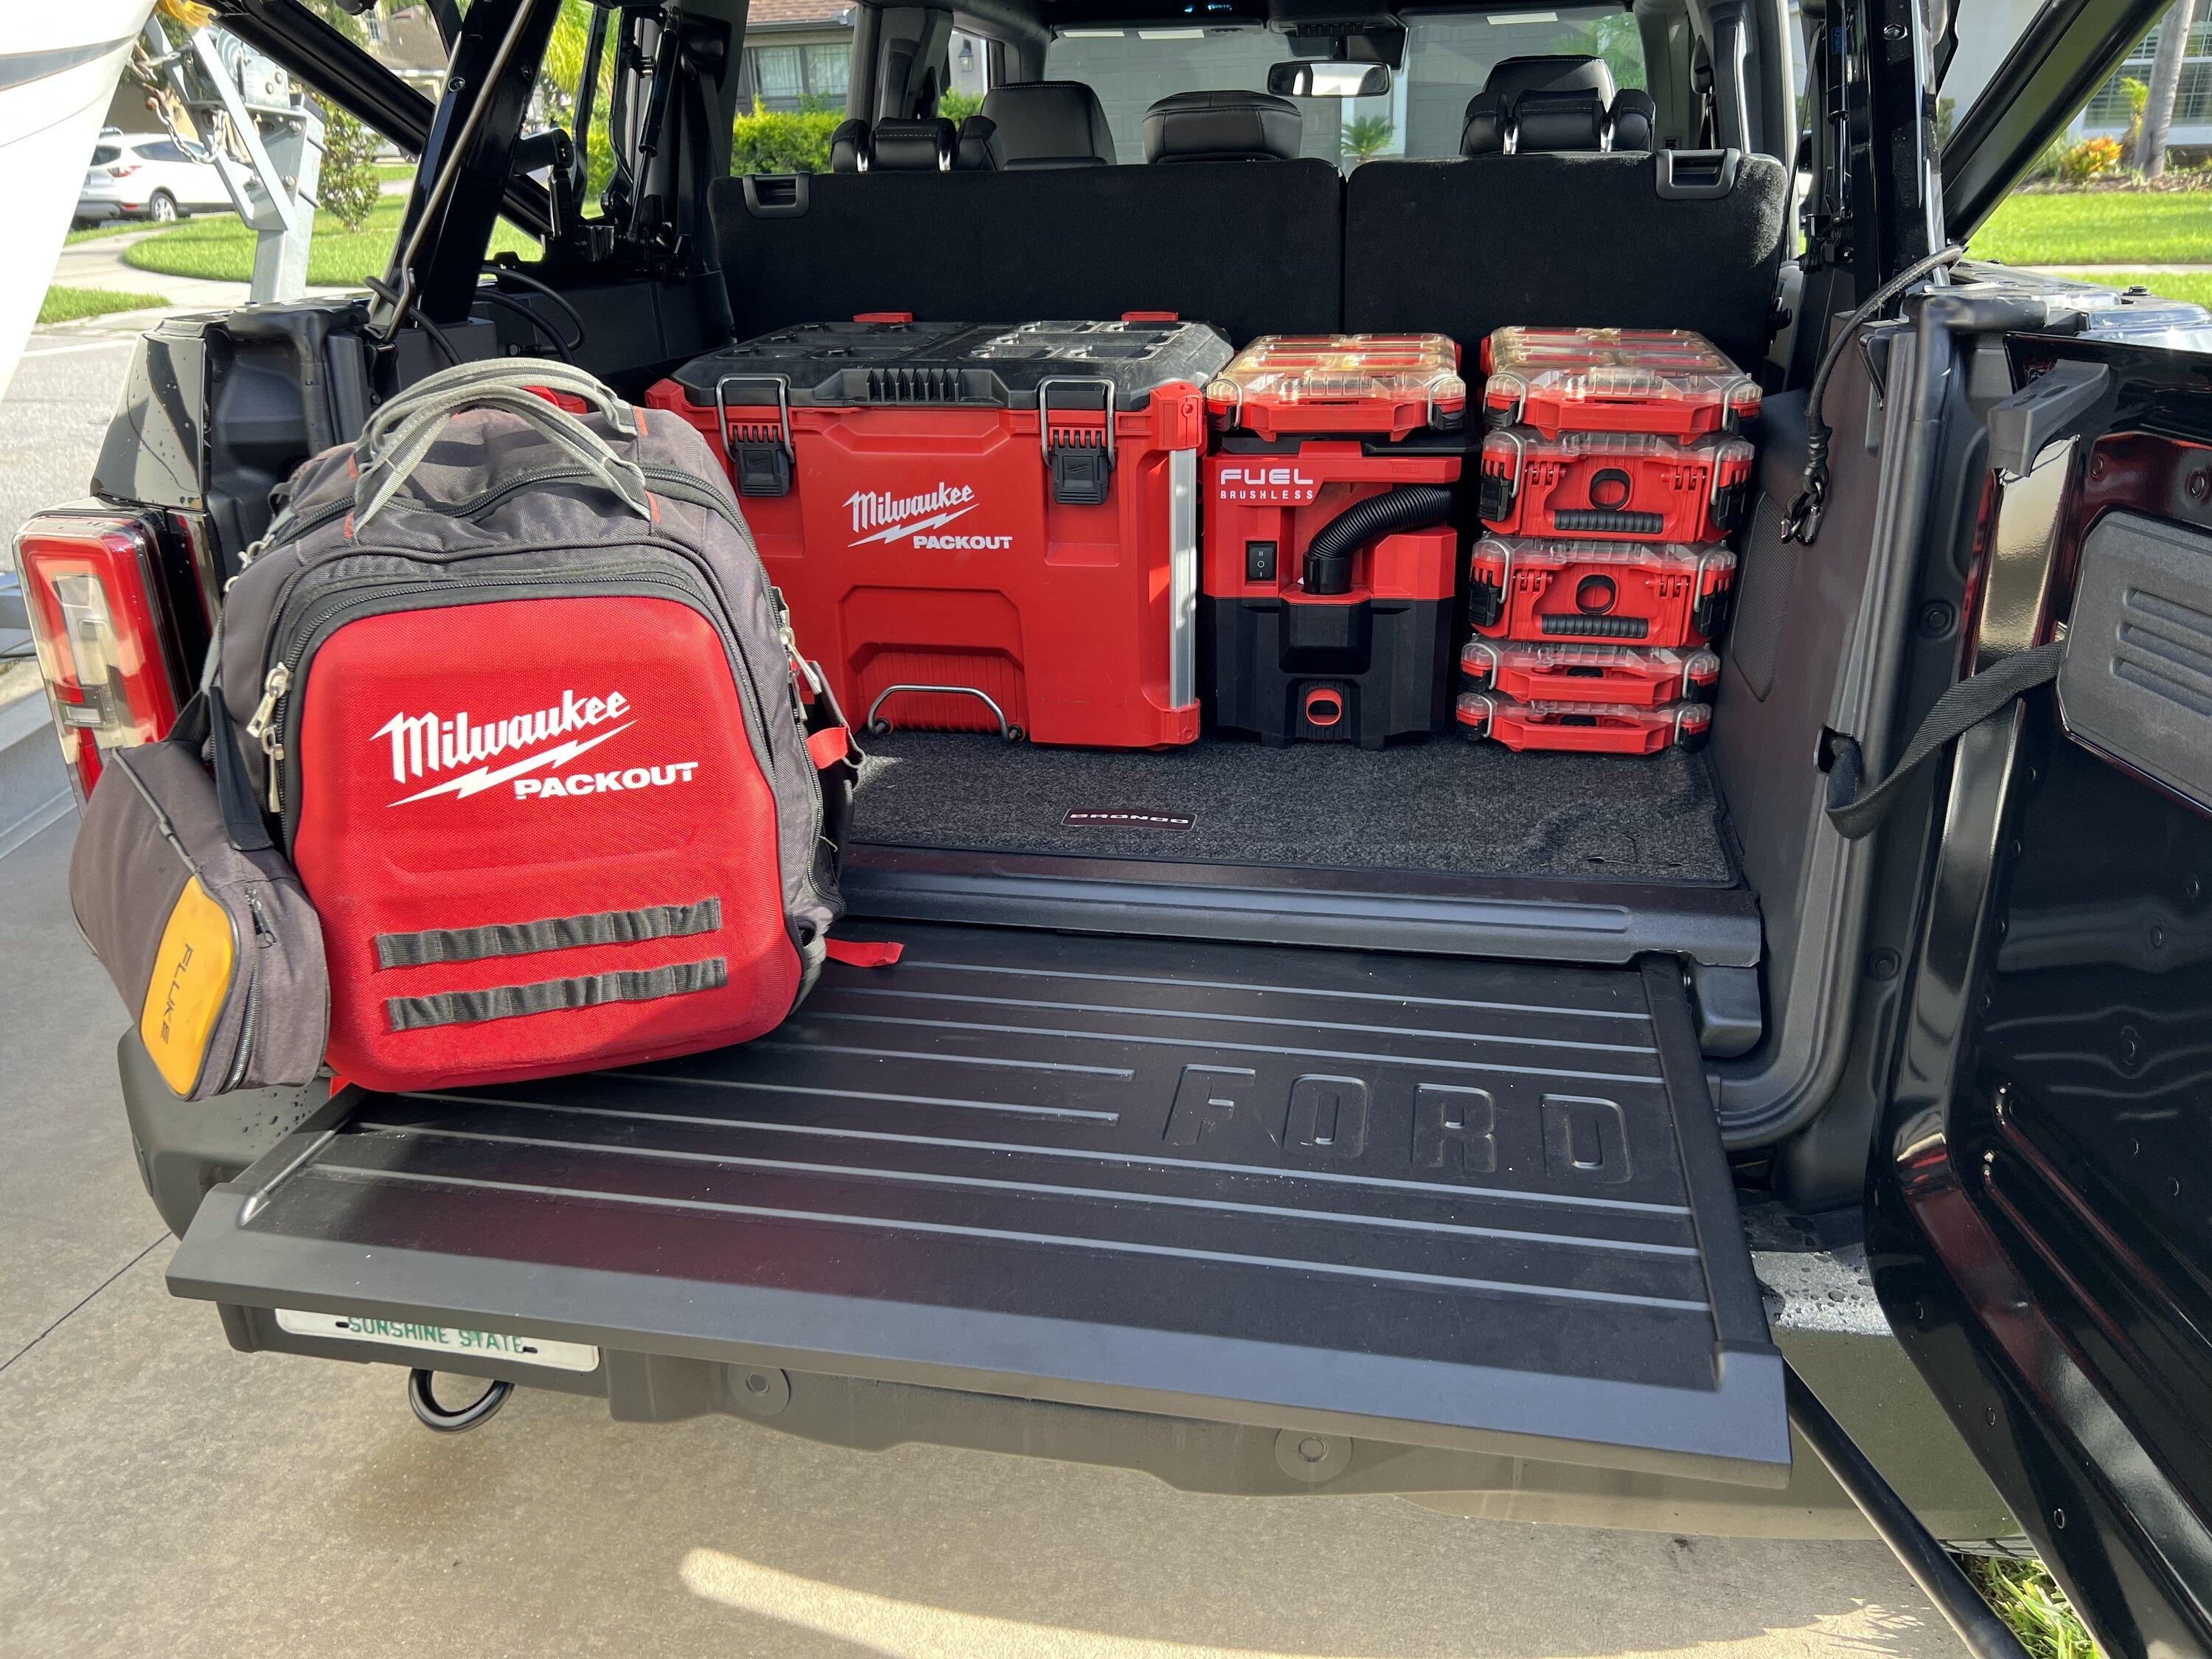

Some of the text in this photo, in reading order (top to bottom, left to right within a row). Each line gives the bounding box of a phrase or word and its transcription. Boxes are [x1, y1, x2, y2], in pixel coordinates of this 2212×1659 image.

[1220, 468, 1314, 485] FUEL
[1220, 489, 1314, 500] BRUSHLESS
[842, 481, 975, 534] Milwaukee
[913, 535, 1014, 550] PACKOUT
[369, 689, 631, 785] Milwaukee
[514, 761, 699, 800] PACKOUT
[1070, 813, 1189, 824] BRONCO
[161, 942, 194, 1045] FLUKE
[1162, 1063, 1633, 1185] FORD
[347, 1315, 524, 1354] SUNSHINE STATE
